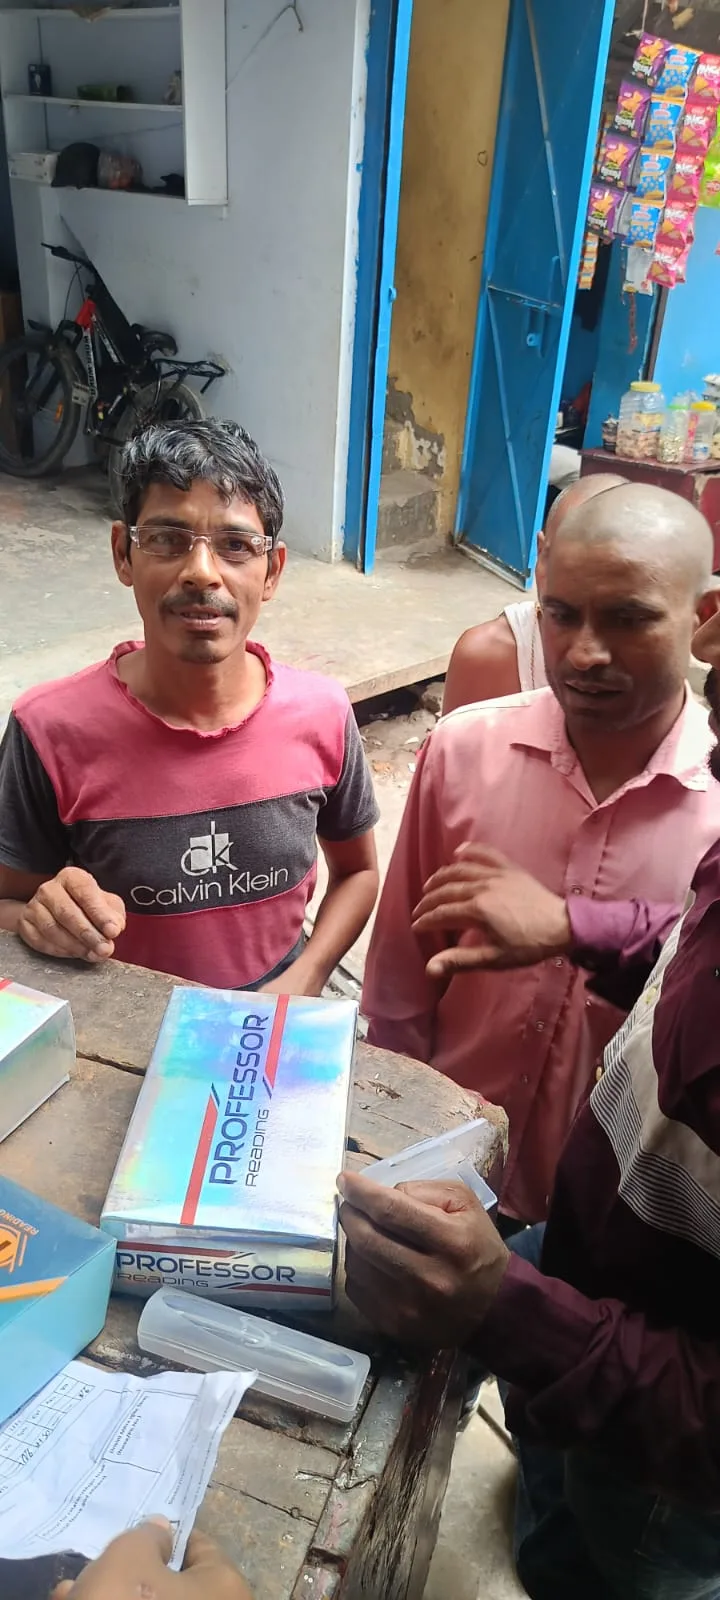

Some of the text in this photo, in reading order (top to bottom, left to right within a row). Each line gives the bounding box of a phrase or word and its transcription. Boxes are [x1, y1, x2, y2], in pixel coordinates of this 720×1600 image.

[130, 866, 289, 906] Calvin Klein
[208, 1014, 270, 1185] PROFESSOR
[115, 1251, 297, 1283] PROFESSOR
